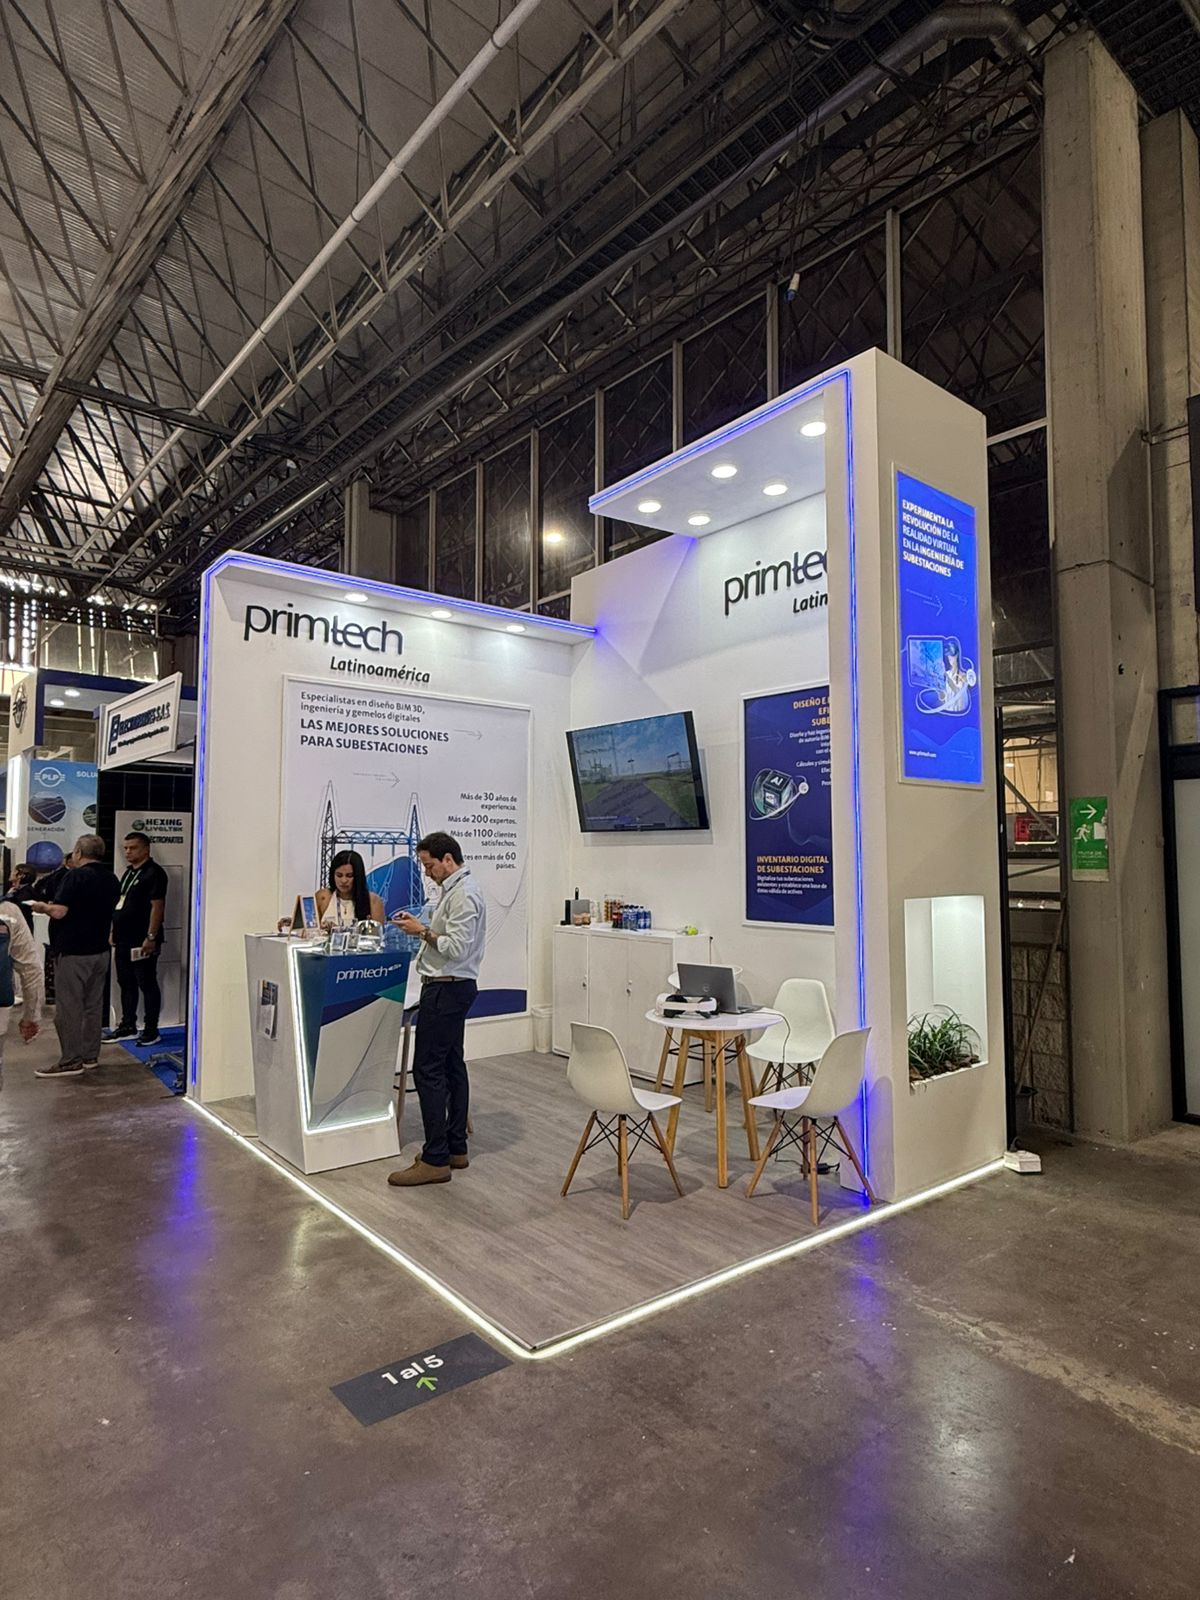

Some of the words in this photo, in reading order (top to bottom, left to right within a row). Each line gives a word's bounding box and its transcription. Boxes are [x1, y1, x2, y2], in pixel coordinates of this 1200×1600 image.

[902, 499, 945, 526] EXPERIMENTA
[946, 518, 954, 529] LA
[902, 511, 941, 536] REVOLUCIÓN
[942, 529, 950, 540] DE
[951, 533, 959, 543] LA
[902, 524, 932, 545] REALIDAD
[933, 536, 958, 555] VIRTUAL
[902, 550, 951, 577] SUBESTACIONES
[903, 537, 911, 549] EN
[912, 541, 919, 553] LA
[920, 544, 955, 567] INGENIERÍA
[956, 559, 964, 570] DE
[793, 591, 828, 614] Latin
[244, 603, 403, 655] primtech
[330, 656, 431, 683] Latinoamérica
[301, 691, 355, 706] Especialistas
[357, 699, 367, 707] en
[368, 698, 394, 710] diseño
[413, 705, 425, 714] 3D,
[301, 702, 344, 715] ingeniería
[345, 709, 350, 717] y
[352, 708, 386, 720] gemelos
[387, 711, 421, 723] digitales
[793, 697, 820, 709] DISEÑO
[301, 718, 323, 730] LAS
[325, 721, 379, 735] MEJORES
[381, 726, 449, 742] SOLUCIONES
[301, 735, 334, 748] PARA
[336, 738, 428, 755] SUBESTACIONES
[42, 773, 60, 781] PLP
[770, 776, 783, 786] AI
[460, 792, 473, 800] Más
[483, 792, 494, 801] 30
[495, 794, 509, 802] años
[146, 818, 182, 826] HEXING
[448, 815, 461, 823] Más
[471, 815, 489, 823] 200
[473, 829, 493, 838] 1100
[483, 853, 495, 861] más
[505, 852, 516, 860] 60
[757, 856, 799, 864] INVENTARIO
[800, 856, 829, 864] DIGITAL
[757, 865, 766, 873] DE
[766, 866, 824, 874] SUBESTACIONES
[336, 966, 388, 984] primtech
[381, 1372, 399, 1385] 1
[400, 1362, 425, 1379] al
[423, 1354, 444, 1368] 5
